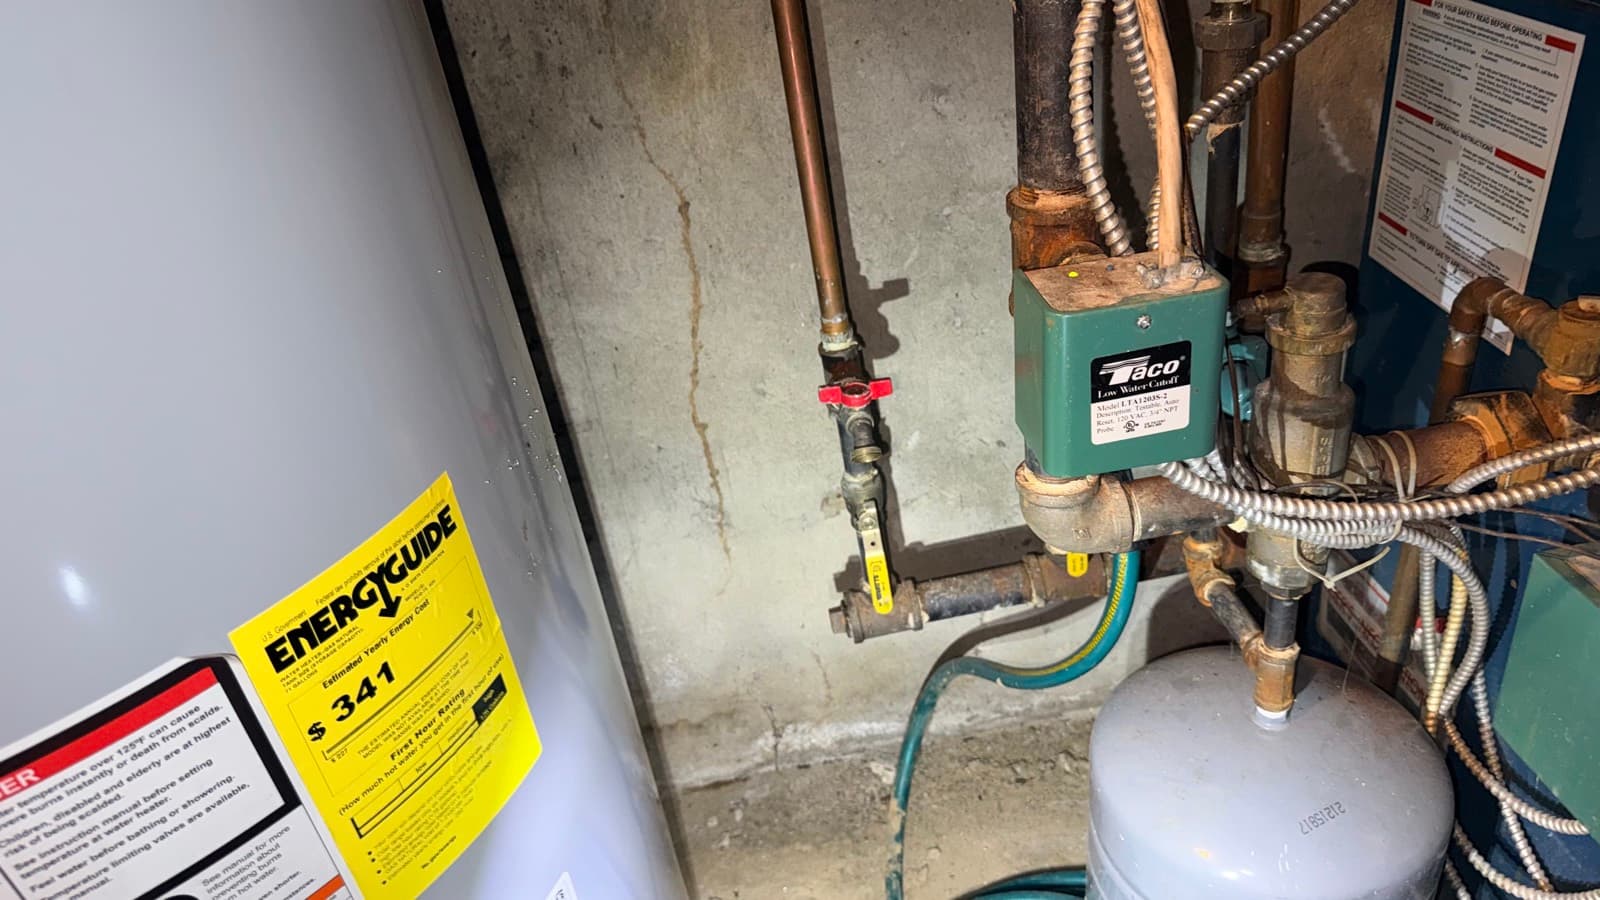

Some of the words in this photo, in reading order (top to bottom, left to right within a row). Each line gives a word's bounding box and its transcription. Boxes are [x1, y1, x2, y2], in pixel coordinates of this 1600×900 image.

[1444, 4, 1458, 13] YOUR
[1458, 8, 1476, 19] SAFETY
[1476, 14, 1490, 24] READ
[1490, 18, 1512, 31] BEFORE
[1512, 24, 1542, 41] OPERATING
[1097, 402, 1120, 412] Model
[1098, 390, 1118, 399] Low
[1120, 383, 1148, 394] Water
[1148, 375, 1180, 388] Cutoff
[1163, 405, 1178, 413] NPT
[264, 504, 457, 674] ENERGYGUIDE
[274, 610, 307, 634] Government
[322, 656, 364, 689] Estimated
[364, 635, 388, 657] Yearly
[388, 614, 414, 637] Energy
[414, 598, 430, 615] Cost
[280, 668, 300, 682] WATER
[308, 722, 326, 742] $
[331, 660, 395, 722] 341
[338, 796, 360, 816] (How
[362, 776, 384, 798] much
[384, 764, 398, 778] hot
[398, 746, 418, 766] water
[419, 734, 433, 749] you
[433, 721, 444, 736] get
[444, 714, 452, 724] in
[451, 703, 462, 716] the
[462, 688, 475, 704] first
[474, 674, 488, 690] hour
[369, 718, 400, 746] ESTIMATED
[390, 738, 414, 760] First
[414, 717, 436, 739] Hour
[438, 688, 465, 718] Rating
[0, 768, 41, 799] ER
[17, 770, 88, 808] temperature
[90, 755, 115, 772] over
[116, 735, 146, 756] 125°F
[148, 724, 168, 740] can
[170, 705, 200, 727] cause
[28, 795, 64, 816] burns
[65, 768, 114, 797] instantly
[116, 760, 128, 770] or
[130, 742, 160, 762] death
[160, 726, 187, 744] from
[188, 704, 224, 728] scalds.
[53, 792, 102, 822] disabled
[103, 780, 125, 795] and
[126, 760, 162, 782] elderly
[164, 748, 181, 762] are
[182, 740, 193, 750] at
[193, 716, 232, 743] highest
[415, 762, 427, 774] low
[4, 844, 27, 858] risk
[29, 834, 42, 846] of
[42, 819, 78, 838] being
[78, 794, 124, 820] scalded.
[14, 858, 37, 870] See
[38, 824, 101, 859] instruction
[102, 800, 142, 826] manual
[142, 780, 177, 804] before
[178, 758, 214, 782] setting
[20, 842, 90, 880] temperature
[91, 834, 104, 844] at
[104, 818, 135, 836] water
[135, 796, 172, 820] heater.
[29, 876, 56, 893] Feel
[57, 860, 88, 879] water
[88, 840, 126, 862] before
[126, 816, 168, 842] bathing
[168, 808, 181, 818] or
[180, 775, 236, 810] showering.
[40, 866, 110, 900] mperature
[110, 842, 152, 868] limiting
[152, 822, 186, 845] valves
[186, 811, 204, 825] are
[201, 872, 222, 888] See
[222, 850, 256, 875] manual
[255, 842, 268, 853] for
[268, 826, 292, 842] more
[206, 860, 256, 895] information
[256, 842, 281, 862] about
[237, 883, 254, 896] hot
[253, 866, 280, 885] water.
[257, 852, 283, 872] burns
